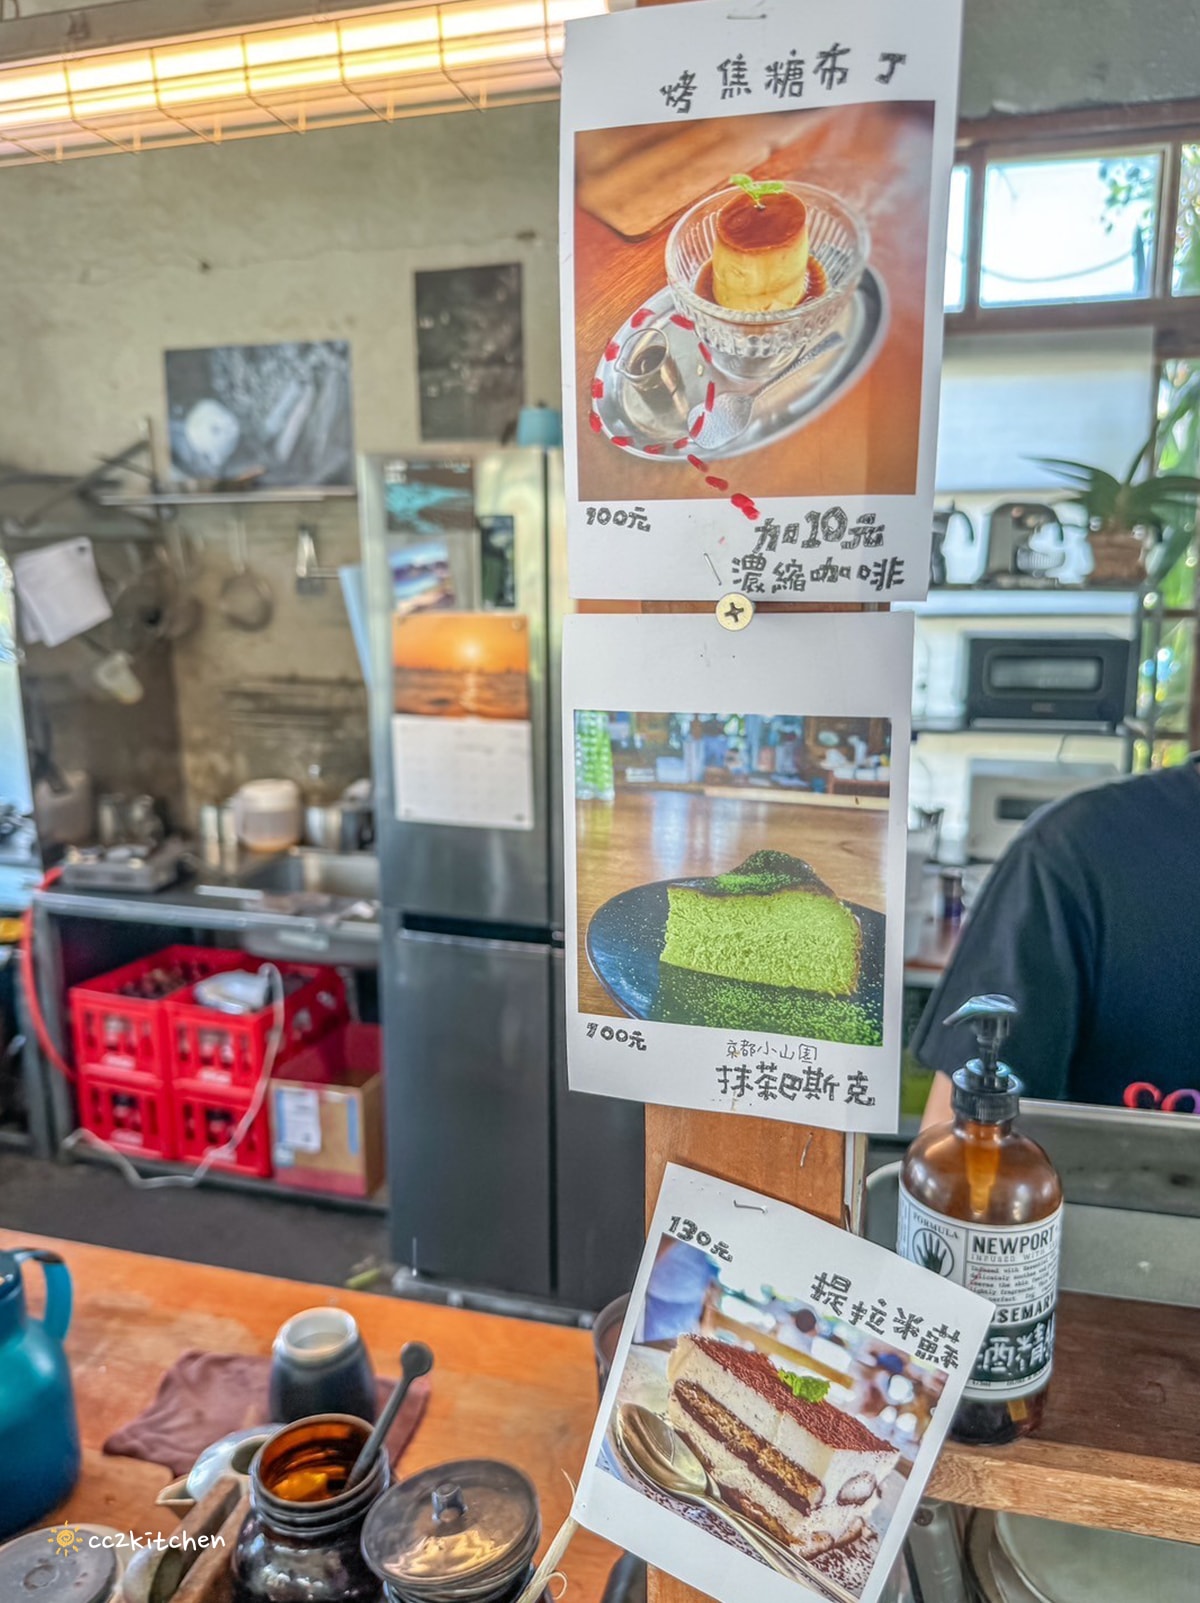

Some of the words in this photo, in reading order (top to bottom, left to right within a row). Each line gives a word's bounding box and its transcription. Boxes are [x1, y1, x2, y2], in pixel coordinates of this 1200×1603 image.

[659, 42, 907, 114] 烤焦糖布丁
[585, 505, 651, 533] 100元
[752, 506, 886, 554] 加10元
[731, 553, 905, 594] 濃縮咖啡
[586, 1022, 647, 1051] 100元
[715, 1061, 876, 1107] 抹茶巴斯克
[667, 1215, 733, 1263] 130元
[913, 1212, 959, 1239] FORMULA
[972, 1225, 1055, 1255] NEWPORT
[810, 1271, 961, 1370] 提拉米蘇
[991, 1291, 1054, 1323] SEMARY
